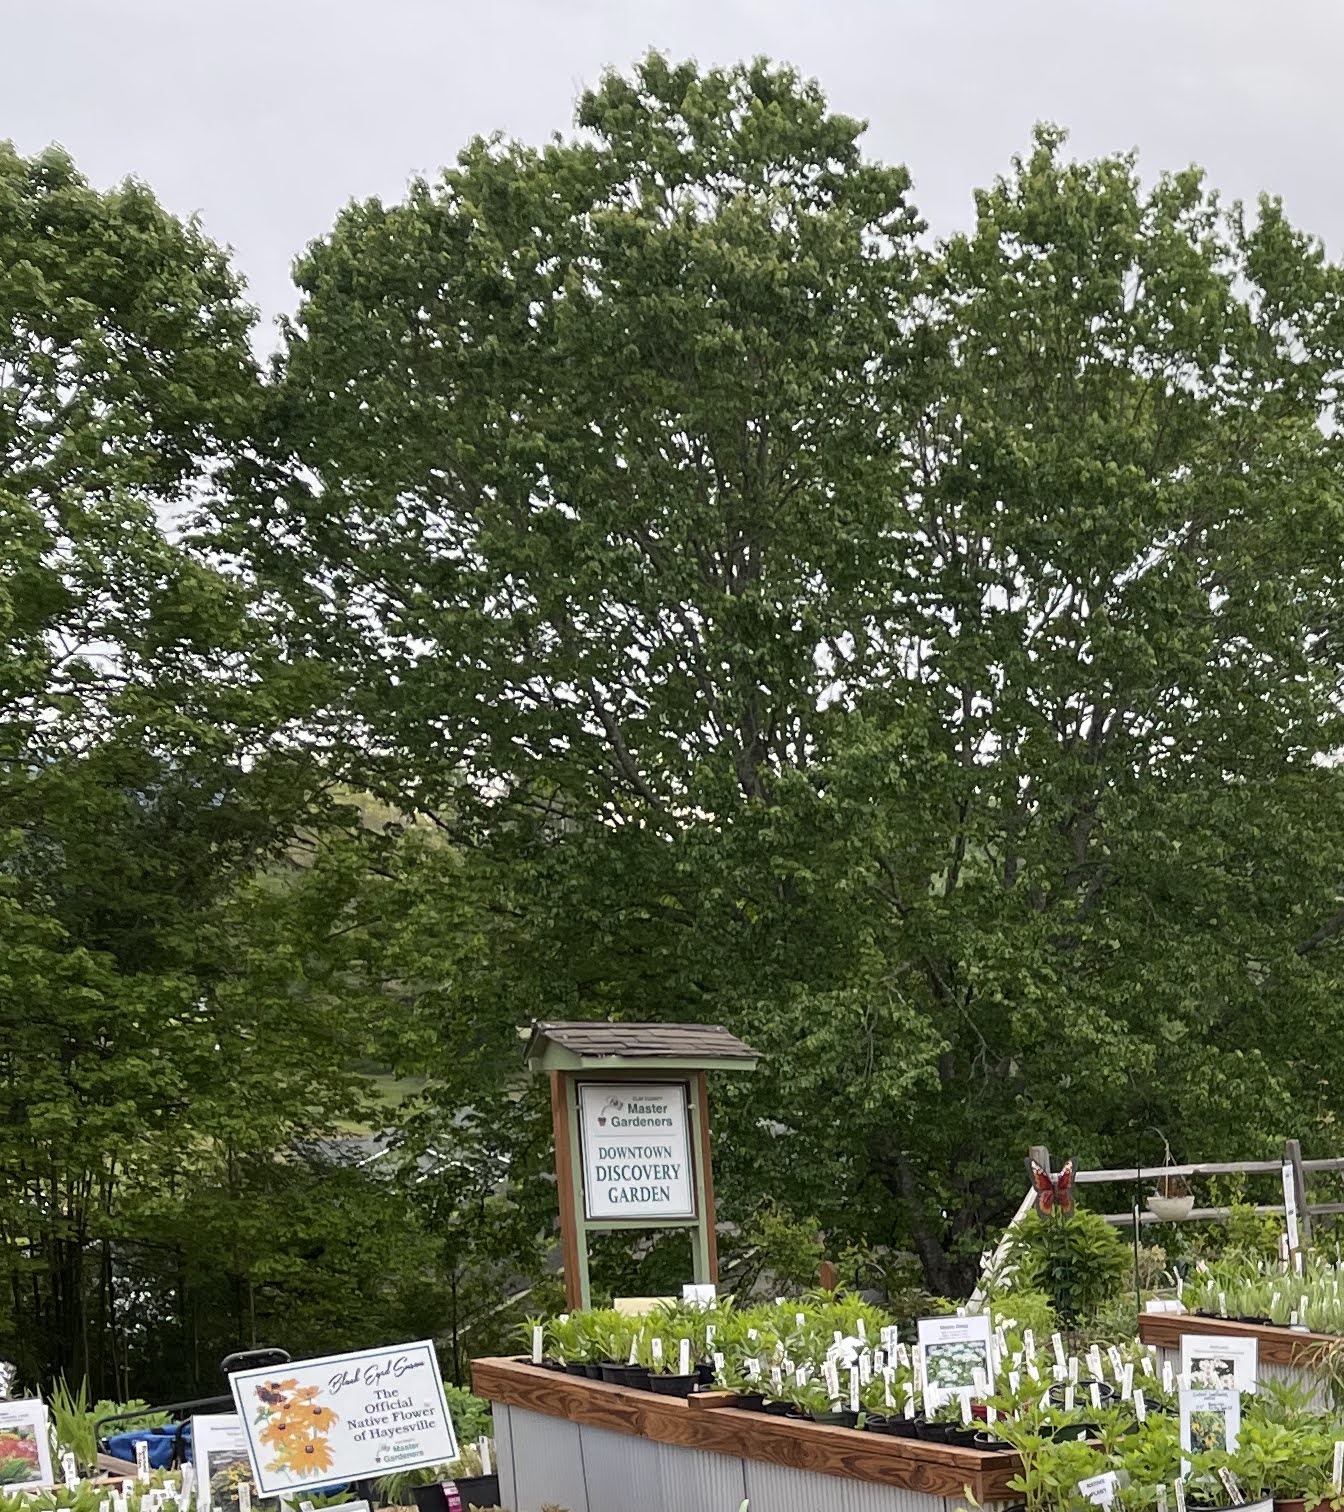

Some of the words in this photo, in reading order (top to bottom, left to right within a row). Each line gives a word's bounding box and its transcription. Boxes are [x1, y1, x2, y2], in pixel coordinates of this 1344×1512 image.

[627, 1103, 668, 1114] Master
[611, 1116, 673, 1127] Gardeners
[598, 1146, 672, 1160] DOWNTOWN
[595, 1164, 681, 1182] DISCOVERY
[608, 1186, 670, 1203] GARDEN
[373, 1388, 399, 1400] The
[364, 1397, 413, 1414] Official
[347, 1416, 389, 1430] Native
[391, 1407, 436, 1423] Flower
[353, 1431, 367, 1442] of
[368, 1419, 436, 1440] Hayesville
